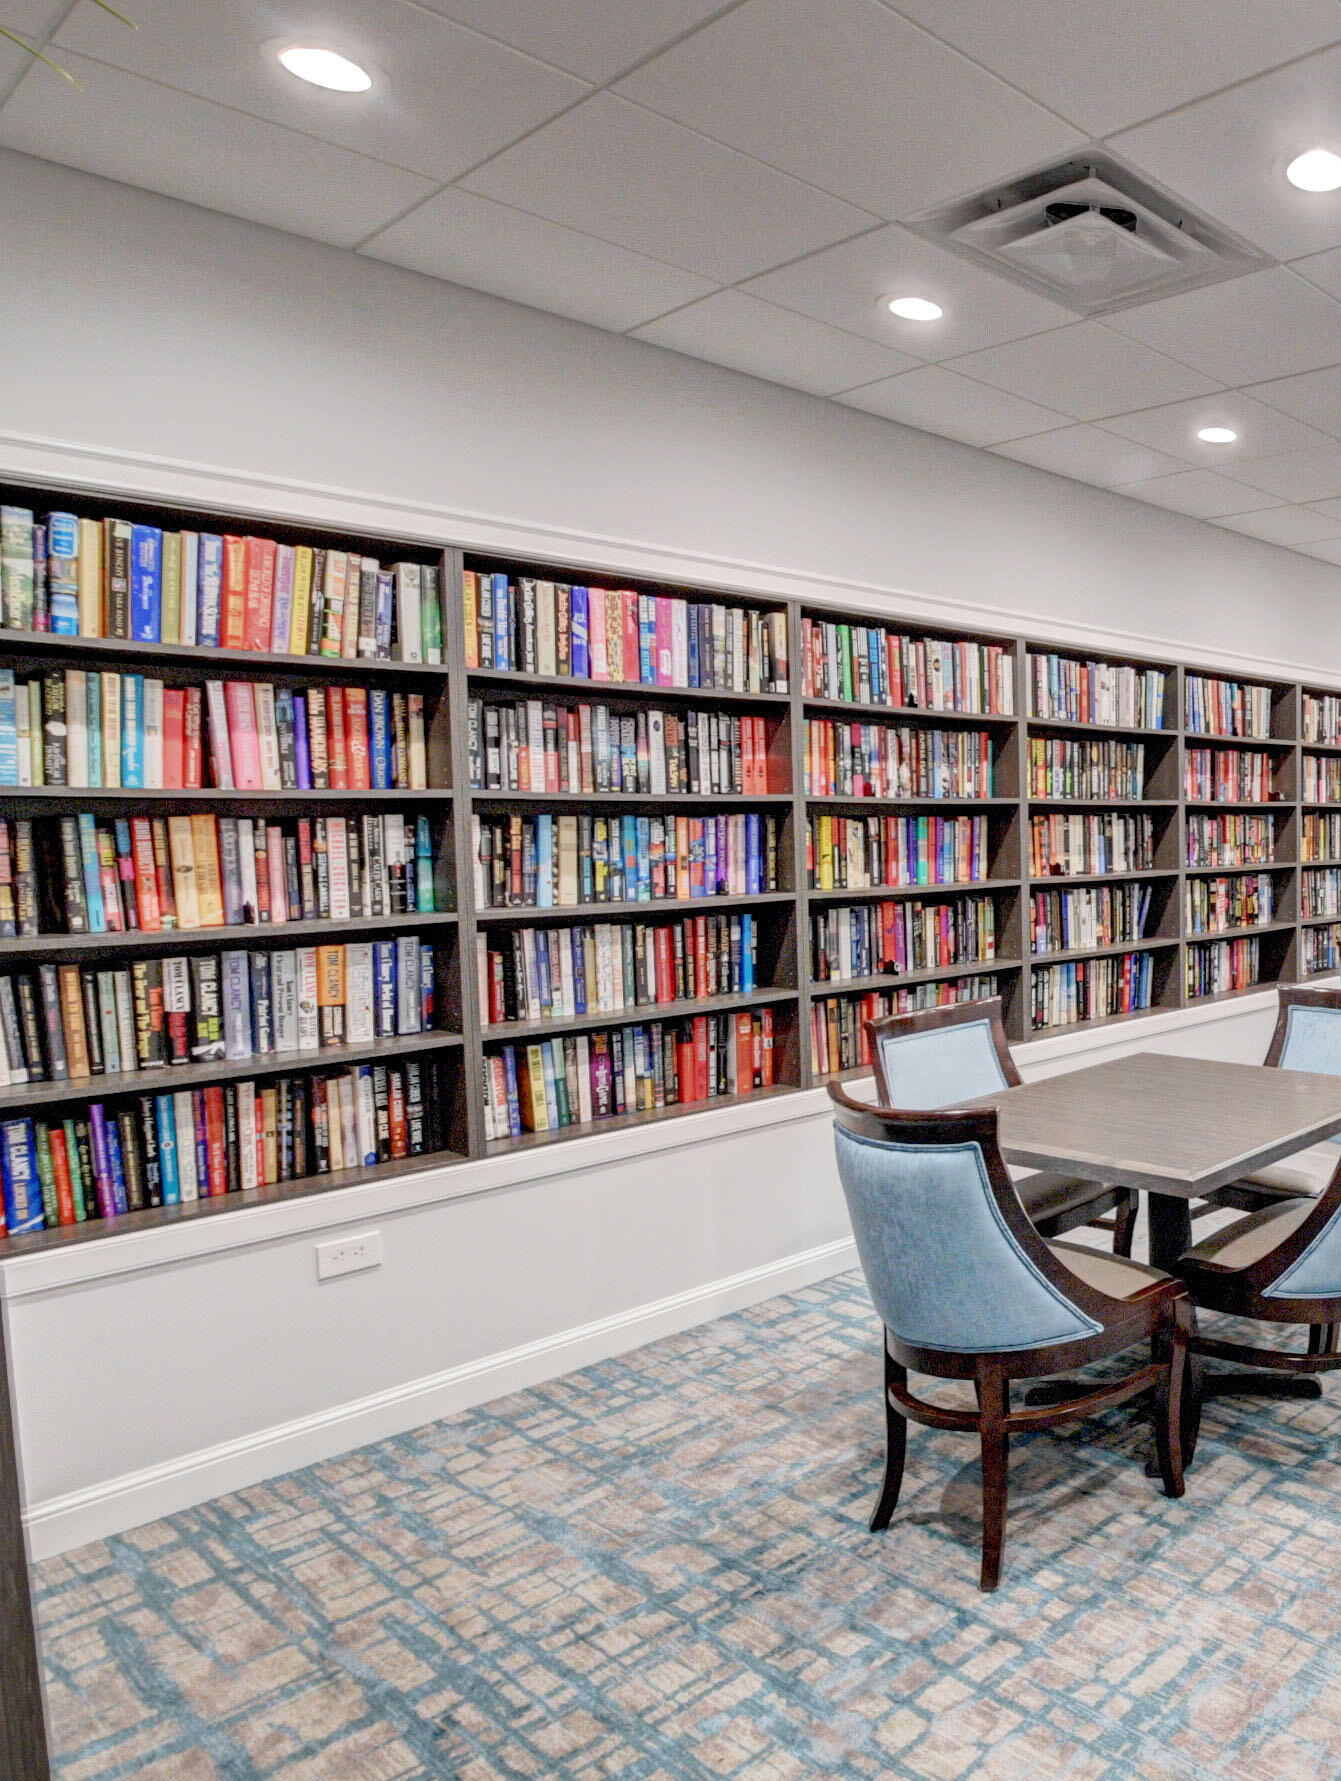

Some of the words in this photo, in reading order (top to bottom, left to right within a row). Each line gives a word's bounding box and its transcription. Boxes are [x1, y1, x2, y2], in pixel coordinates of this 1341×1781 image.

[374, 692, 385, 713] DAN
[468, 702, 478, 719] TOM
[374, 715, 385, 749] BROWN
[468, 720, 478, 752] CLANCY
[304, 951, 317, 969] TOM
[327, 950, 340, 967] TOM
[404, 941, 416, 958] TOM
[172, 961, 184, 978] TOM
[200, 960, 217, 980] TOM
[229, 956, 241, 975] TOM
[405, 959, 418, 991] CLANCY
[172, 979, 186, 1010] CLANCY
[230, 975, 243, 1011] CLANCY
[304, 970, 318, 1000] CLANCY
[327, 968, 342, 1000] CLANCY
[200, 981, 219, 1016] CLANCY
[276, 987, 286, 1014] Present
[7, 1122, 28, 1145] TOM
[9, 1145, 32, 1181] CLANCY
